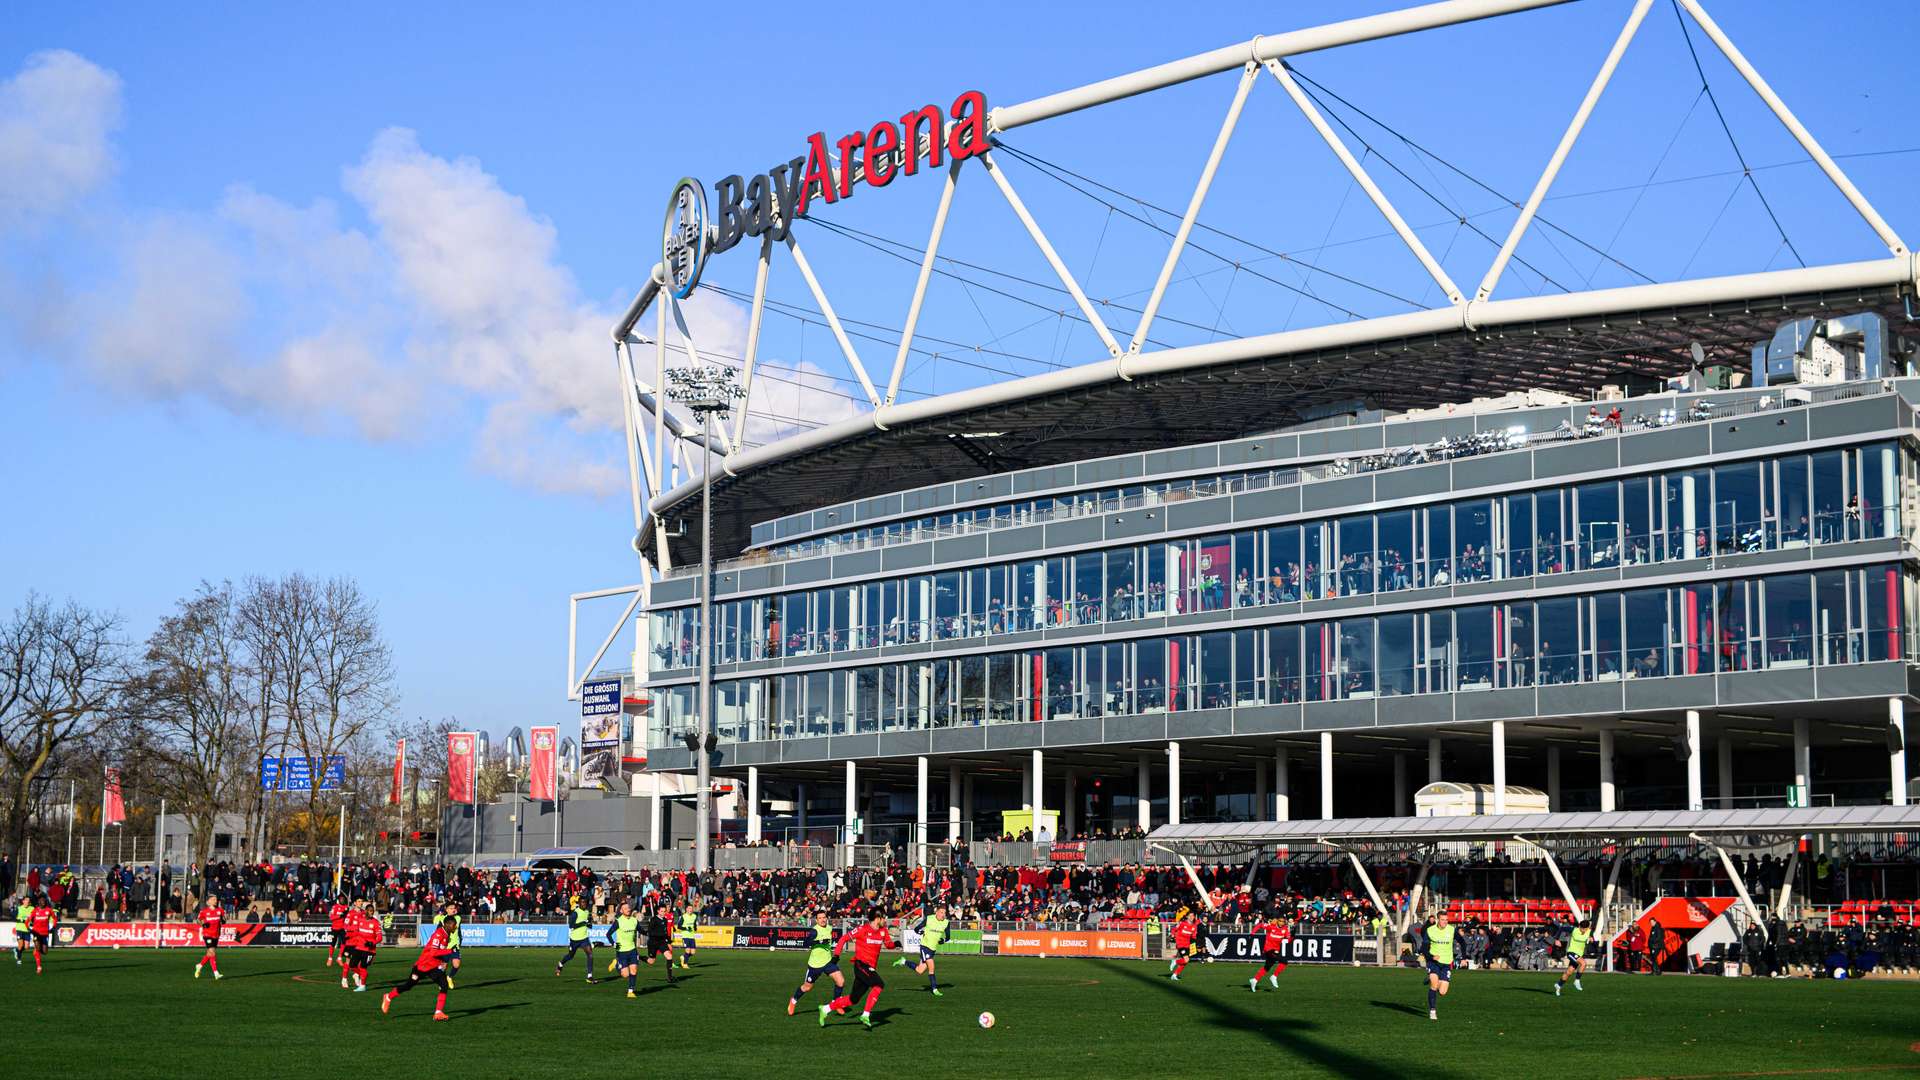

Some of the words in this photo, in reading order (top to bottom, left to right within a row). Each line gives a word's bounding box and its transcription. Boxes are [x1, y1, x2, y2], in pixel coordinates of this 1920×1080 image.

[714, 89, 995, 254] BayArena
[665, 222, 700, 258] BAYER
[584, 686, 593, 694] DIE
[594, 683, 618, 694] GRÖSSTE
[584, 694, 610, 704] AUSWAHL
[584, 706, 594, 714] DER
[595, 703, 618, 713] REGION!
[87, 928, 188, 940] FUSSBALLSCHULE
[461, 927, 485, 937] menia
[506, 927, 548, 937] Barmenia
[280, 932, 334, 945] bayer04.de
[736, 934, 769, 946] BayArena
[1014, 939, 1041, 947] LEDVANCE
[1059, 940, 1088, 948] LEDVANCE
[1107, 941, 1136, 949] LEDVANCE
[1236, 937, 1332, 958] CATORE
